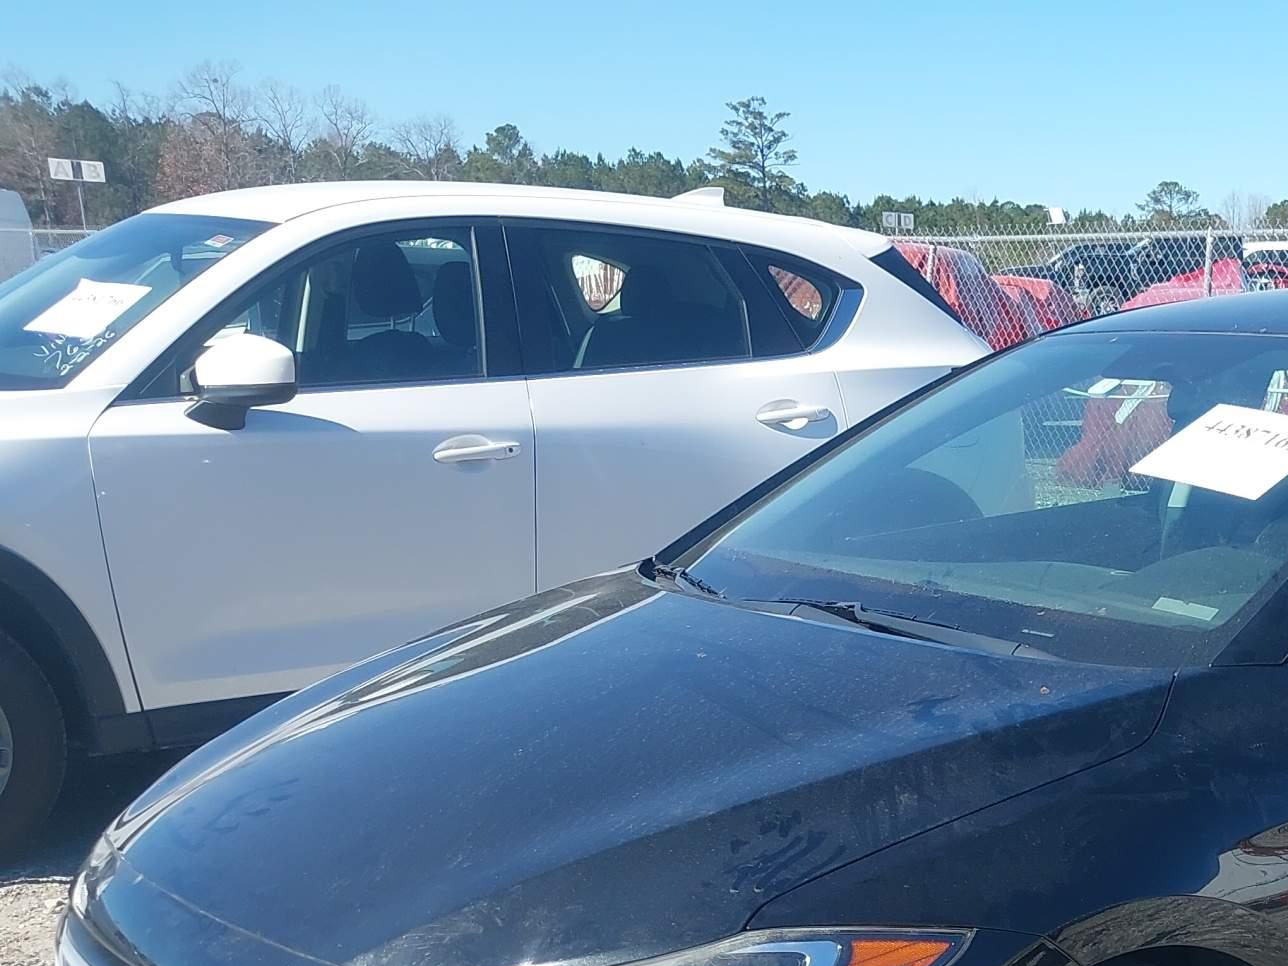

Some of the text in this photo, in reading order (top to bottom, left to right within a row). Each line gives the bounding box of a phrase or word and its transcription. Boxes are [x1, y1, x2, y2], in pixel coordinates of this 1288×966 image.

[54, 161, 100, 178] A B
[885, 213, 912, 227] C D
